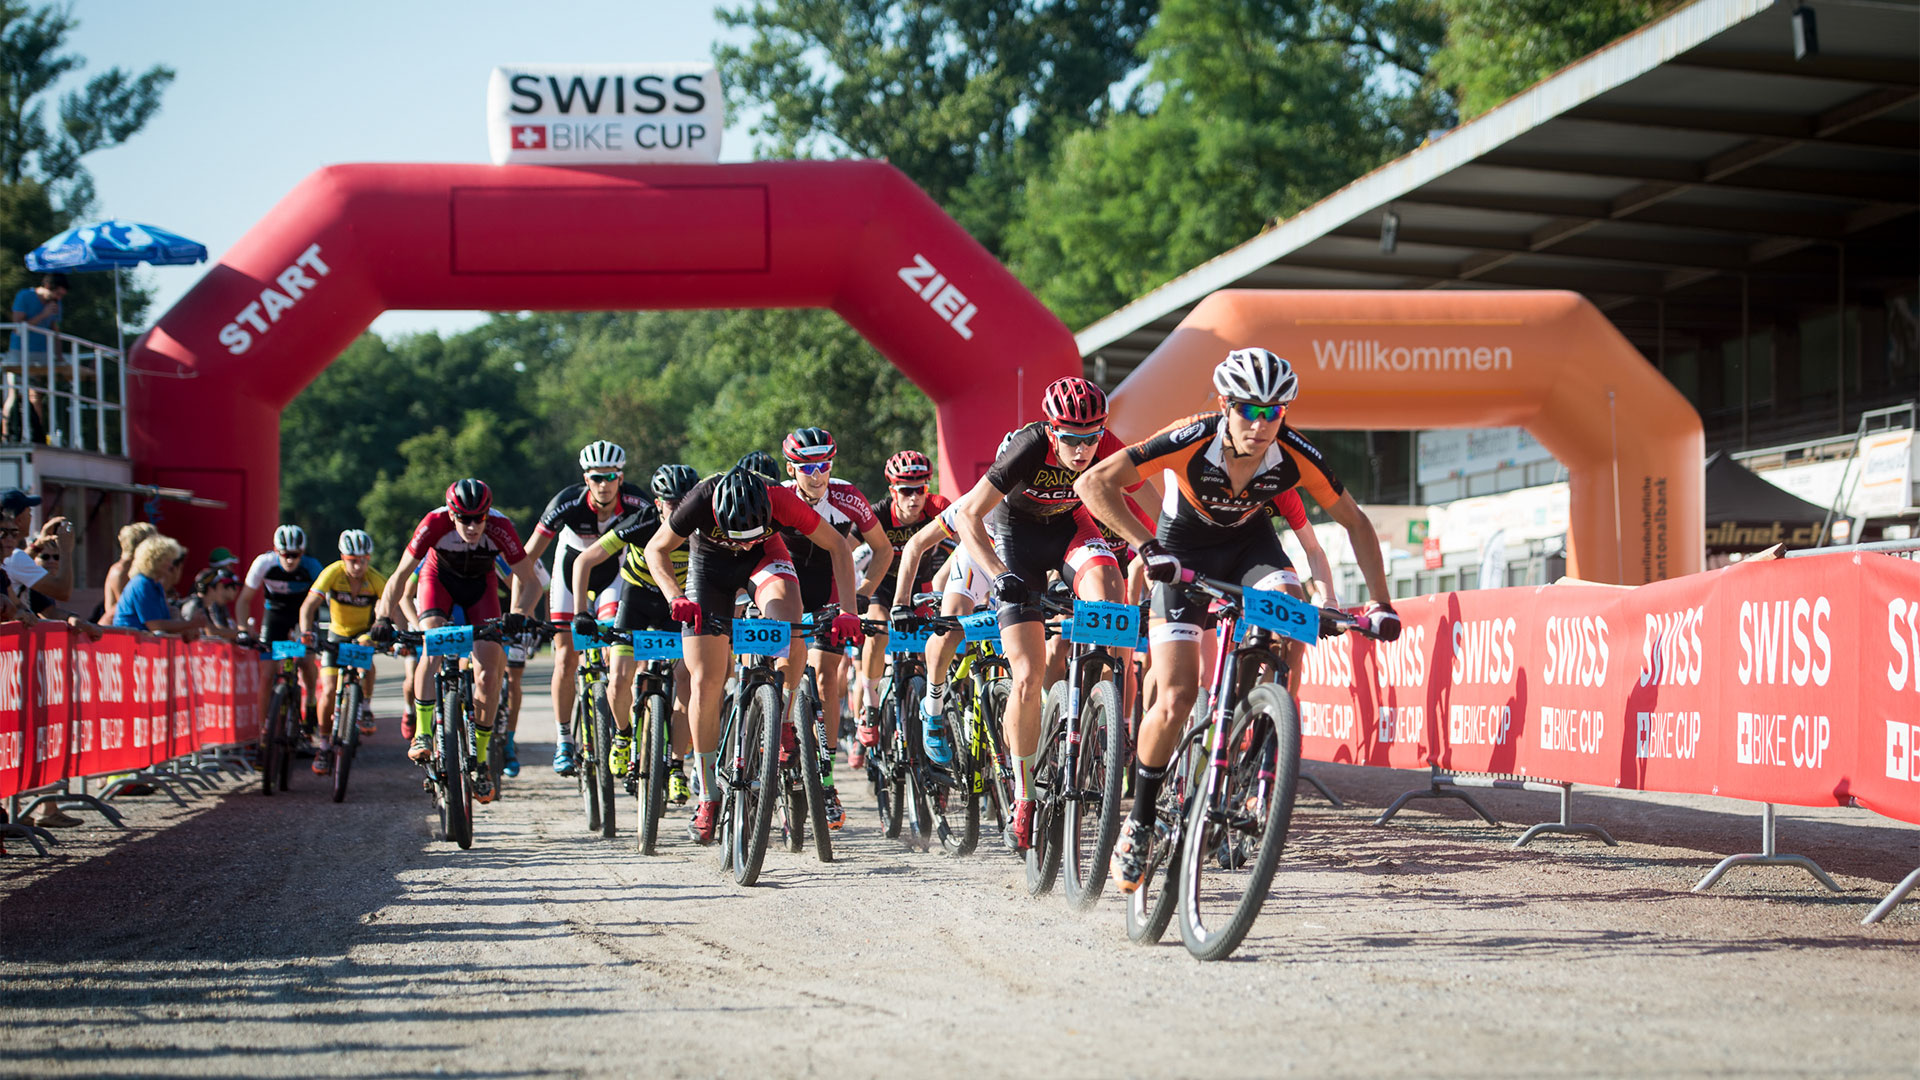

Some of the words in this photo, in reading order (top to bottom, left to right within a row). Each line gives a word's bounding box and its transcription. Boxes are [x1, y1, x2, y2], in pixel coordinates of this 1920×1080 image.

[510, 75, 706, 114] SWISS
[552, 123, 622, 150] BIKE
[635, 123, 706, 149] CUP
[218, 242, 331, 355] START
[897, 253, 978, 340] ZIEL
[1312, 340, 1512, 371] Willkommen
[1025, 488, 1080, 499] RACI
[1034, 469, 1082, 487] PAM
[1654, 477, 1668, 580] antonalbank
[973, 616, 998, 628] 30
[1086, 612, 1129, 631] 310
[1260, 599, 1307, 625] 303
[434, 631, 465, 645] 343
[643, 638, 675, 649] 314
[744, 629, 782, 642] 308
[1452, 617, 1516, 685] SWISS
[1543, 615, 1609, 687] SWISS
[1640, 605, 1703, 687] SWISS
[1738, 596, 1831, 686] SWISS
[1376, 625, 1424, 688] SWISS
[1311, 703, 1331, 737] BIKE
[1333, 704, 1353, 739] CUP
[1388, 707, 1405, 742] BIKE
[1406, 706, 1424, 743] CUP
[1464, 705, 1486, 744] BIKE
[1488, 705, 1511, 745] CUP
[1554, 708, 1577, 751] BIKE
[1580, 710, 1604, 754] CUP
[1650, 712, 1674, 758] BIKE
[1676, 711, 1700, 760] CUP
[1753, 714, 1786, 766] BIKE
[1792, 715, 1830, 768] CUP
